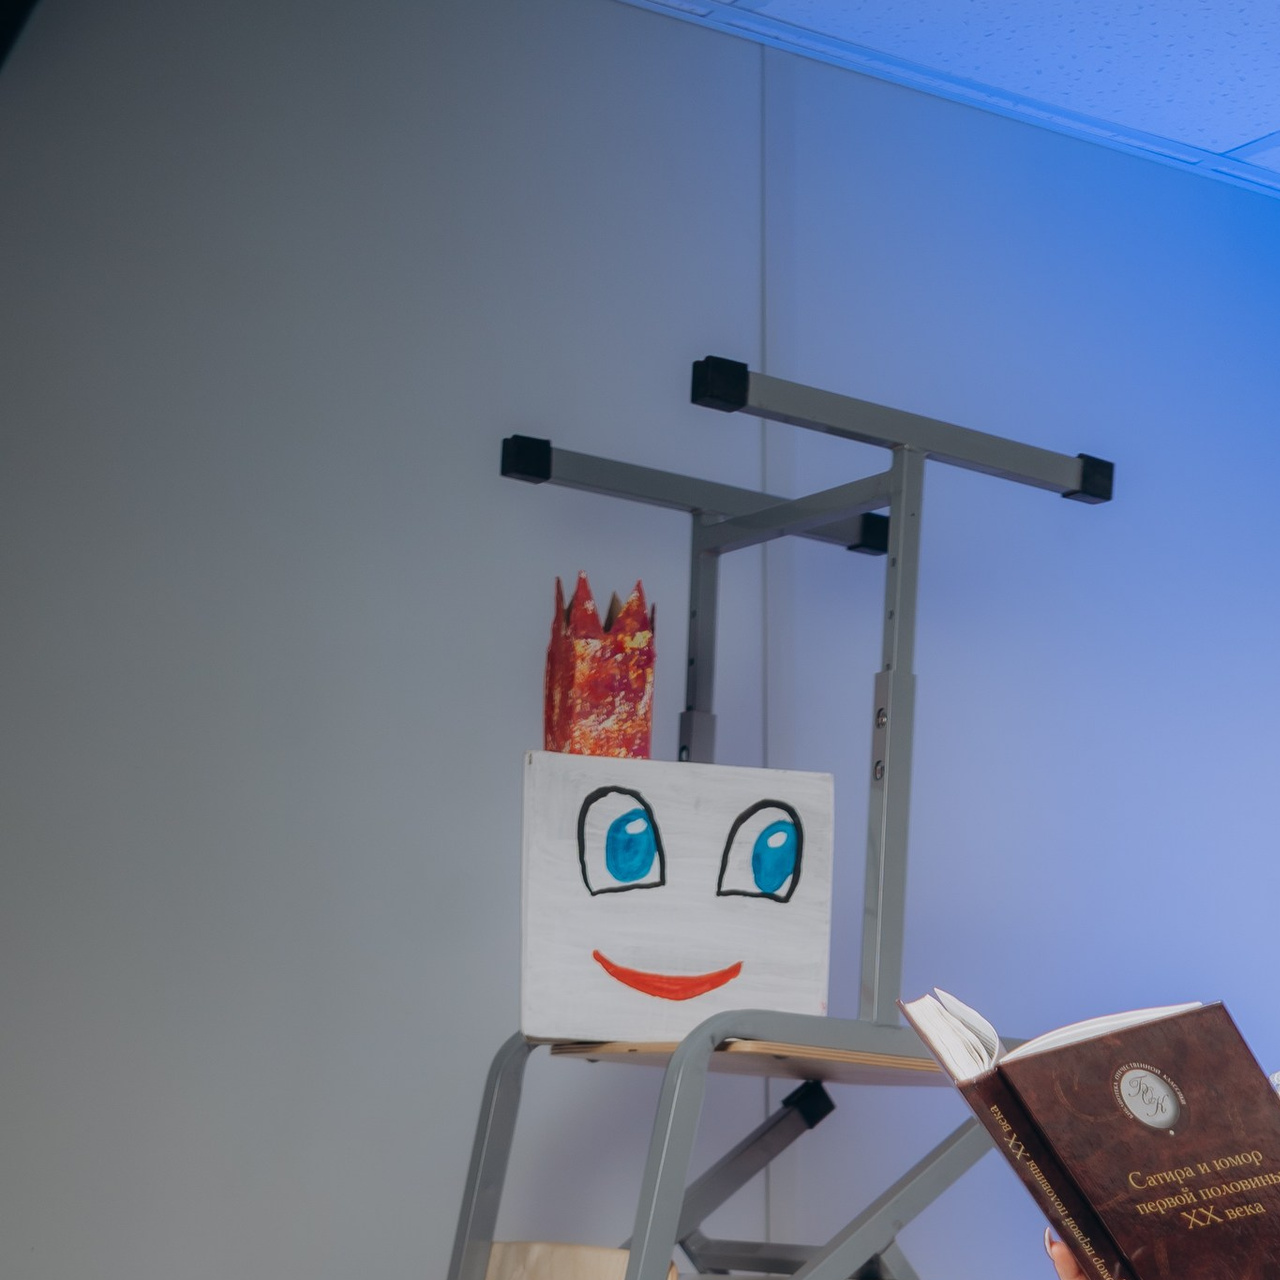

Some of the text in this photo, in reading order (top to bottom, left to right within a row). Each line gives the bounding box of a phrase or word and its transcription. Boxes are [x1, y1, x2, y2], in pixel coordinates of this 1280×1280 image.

[989, 1104, 1012, 1133] века
[1128, 1150, 1263, 1190] Сатира и юмор
[1026, 1159, 1068, 1216] половины
[1136, 1187, 1198, 1216] первой
[1224, 1202, 1267, 1221] века
[1062, 1217, 1096, 1257] первой
